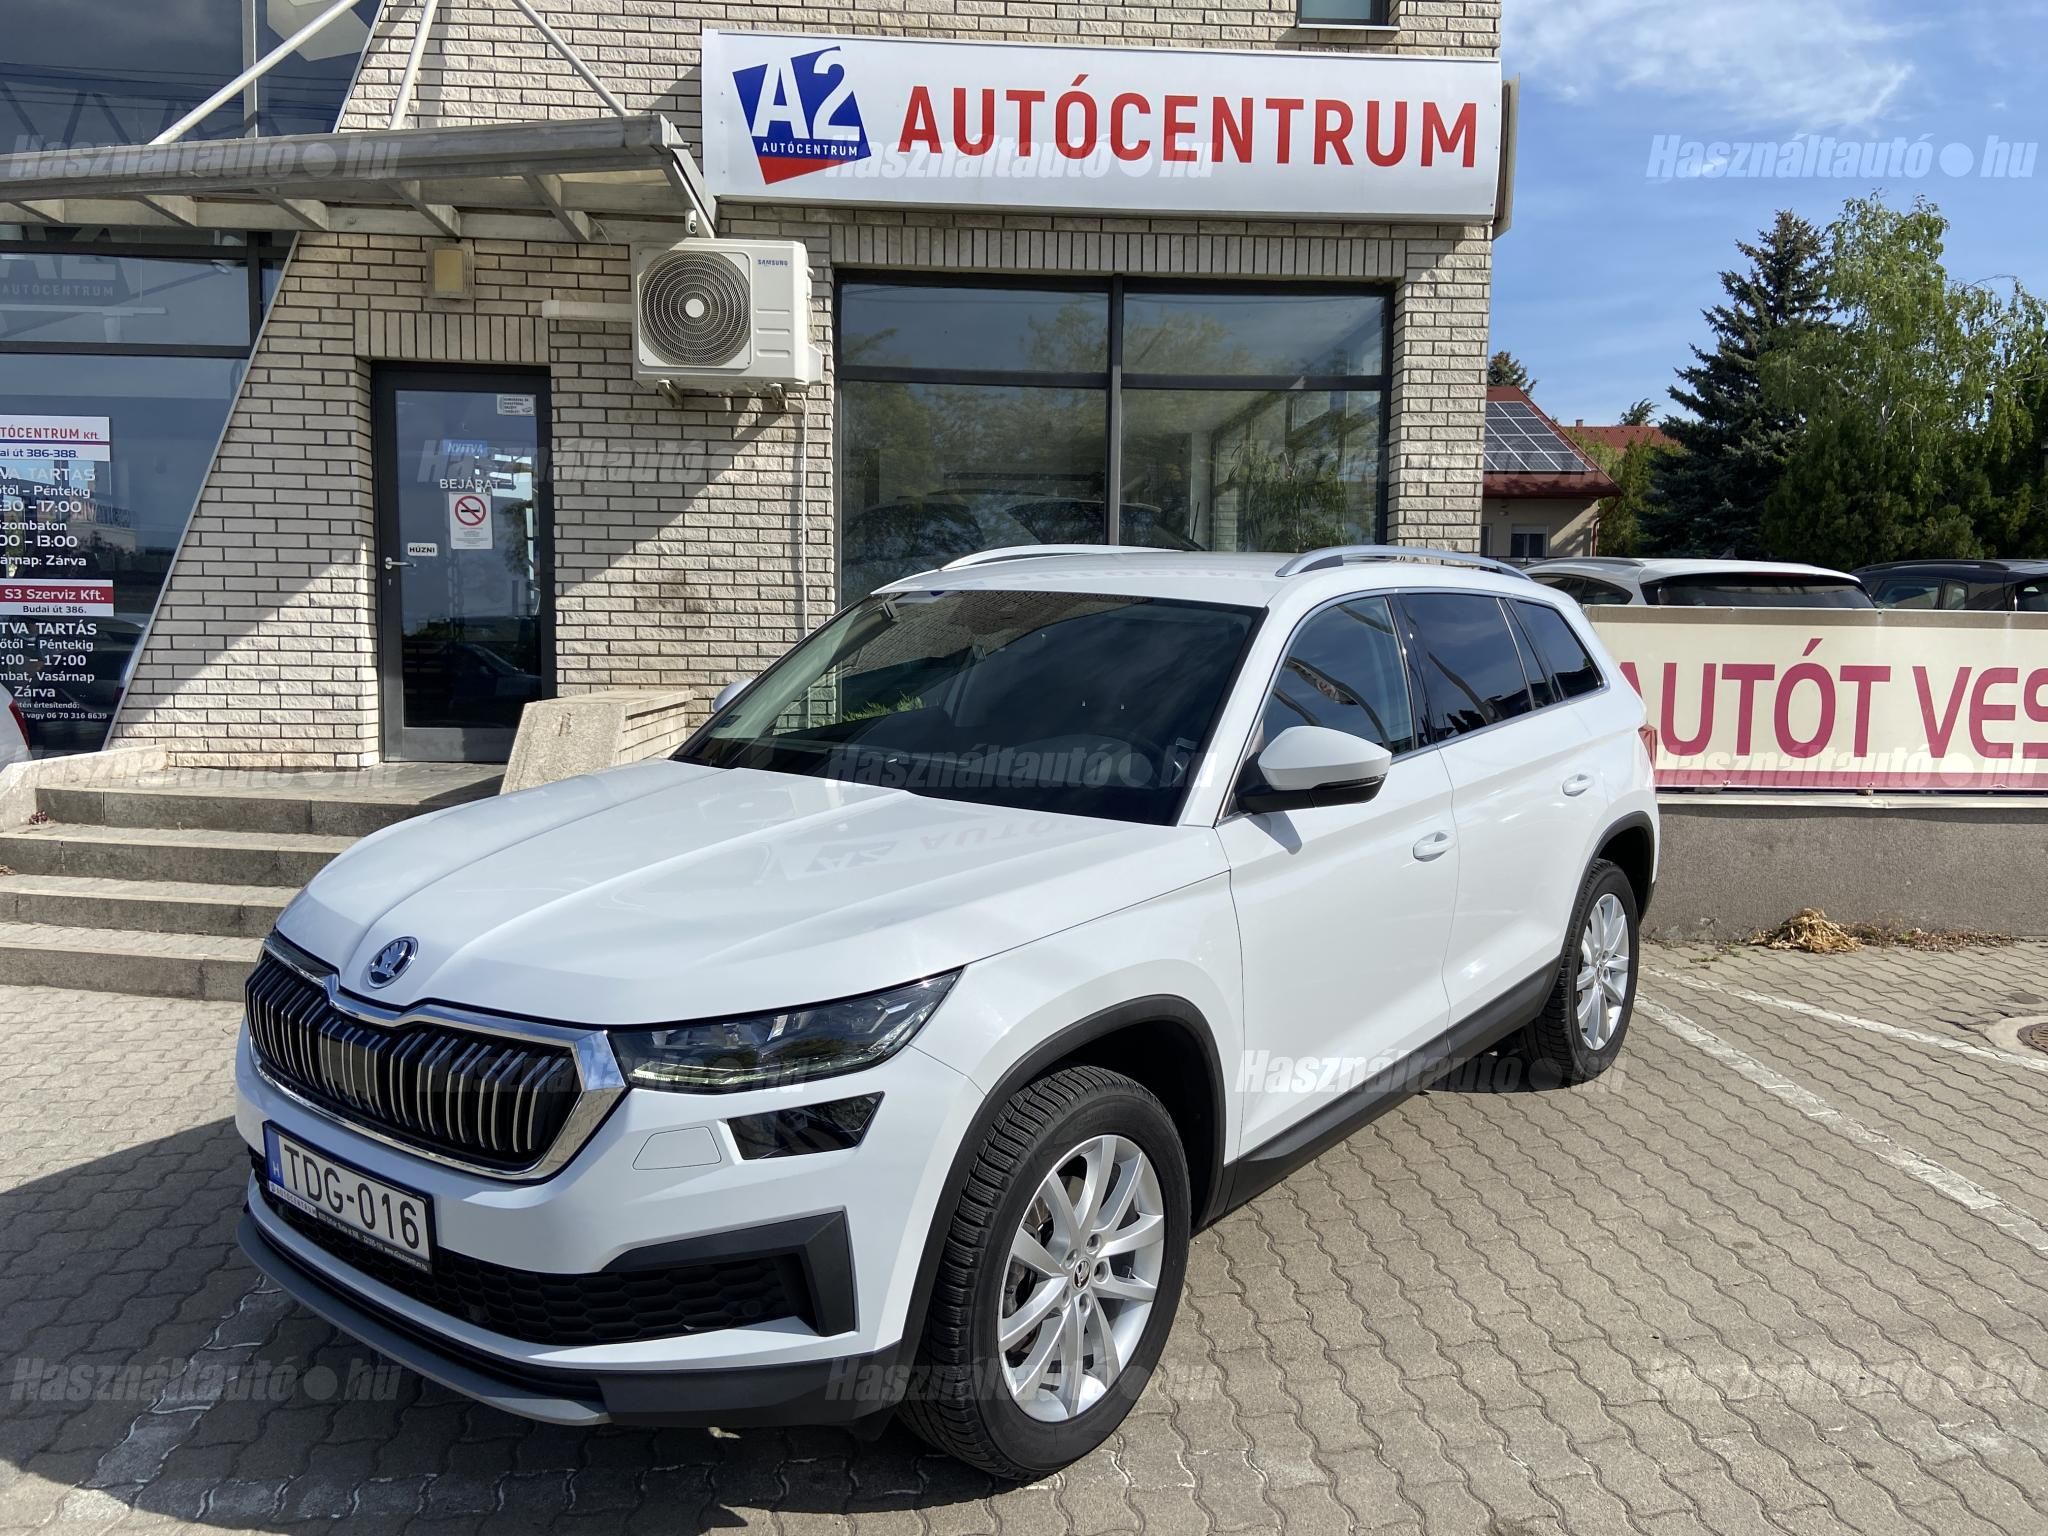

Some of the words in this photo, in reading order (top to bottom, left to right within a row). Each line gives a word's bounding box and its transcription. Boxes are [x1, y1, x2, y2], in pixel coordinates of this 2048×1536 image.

[752, 50, 860, 141] A2
[898, 74, 1477, 168] AUTÓCENTRUM
[762, 141, 857, 156] AUTÓCENTRUM
[440, 476, 500, 489] BEJÁRAT
[37, 535, 78, 547] 13:00
[45, 554, 87, 566] Zárva
[4, 588, 22, 599] S3
[26, 588, 76, 600] Szerviz
[80, 589, 105, 601] Kft.
[23, 605, 50, 613] Budai
[52, 605, 63, 613] út
[66, 606, 87, 614] 386.
[36, 619, 97, 635] TARTÁS
[39, 639, 94, 652] Péntekig
[44, 654, 86, 666] 17:00
[36, 671, 95, 684] Vasárnap
[14, 685, 56, 697] Zárva
[1619, 638, 1891, 758] UTÓT
[284, 1144, 420, 1250] TDG-016
